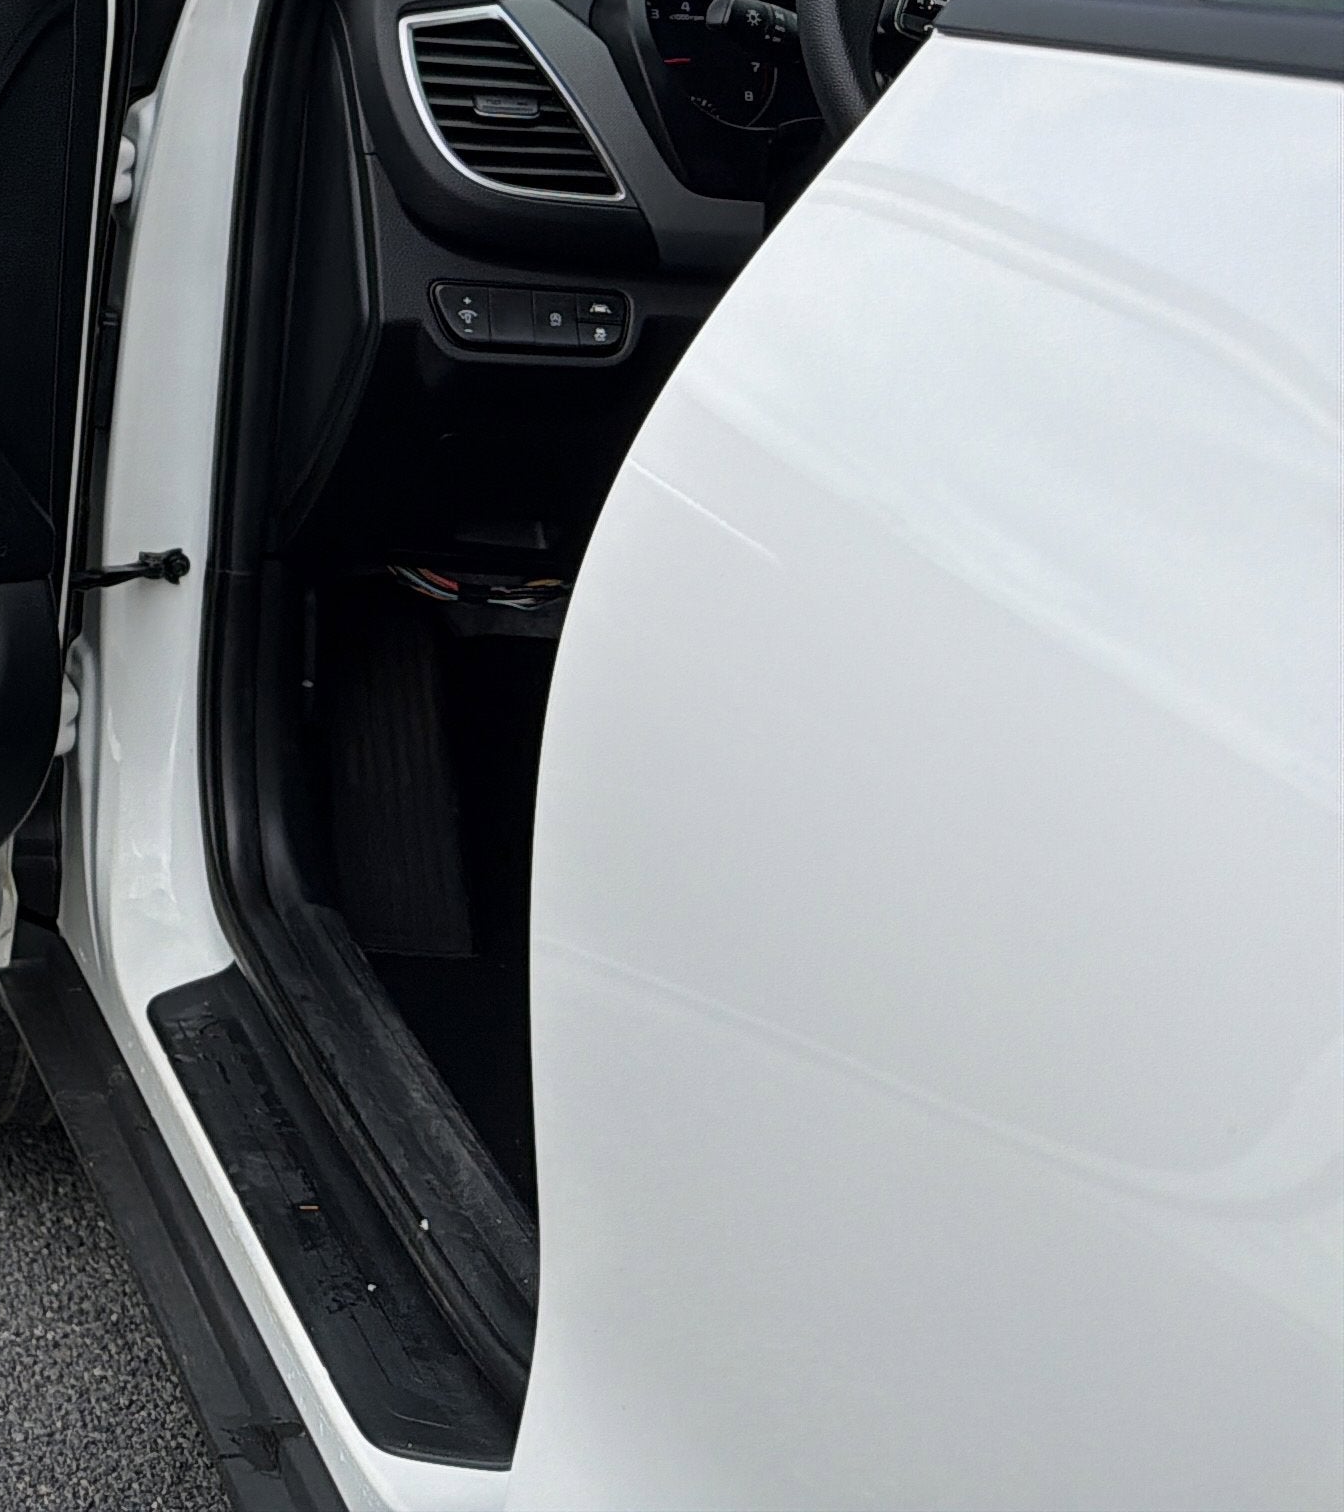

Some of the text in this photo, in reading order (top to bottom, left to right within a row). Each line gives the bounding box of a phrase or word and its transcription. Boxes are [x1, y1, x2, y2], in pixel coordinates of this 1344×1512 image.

[680, 1, 691, 12] 4
[650, 8, 660, 19] 3
[750, 61, 761, 73] 7
